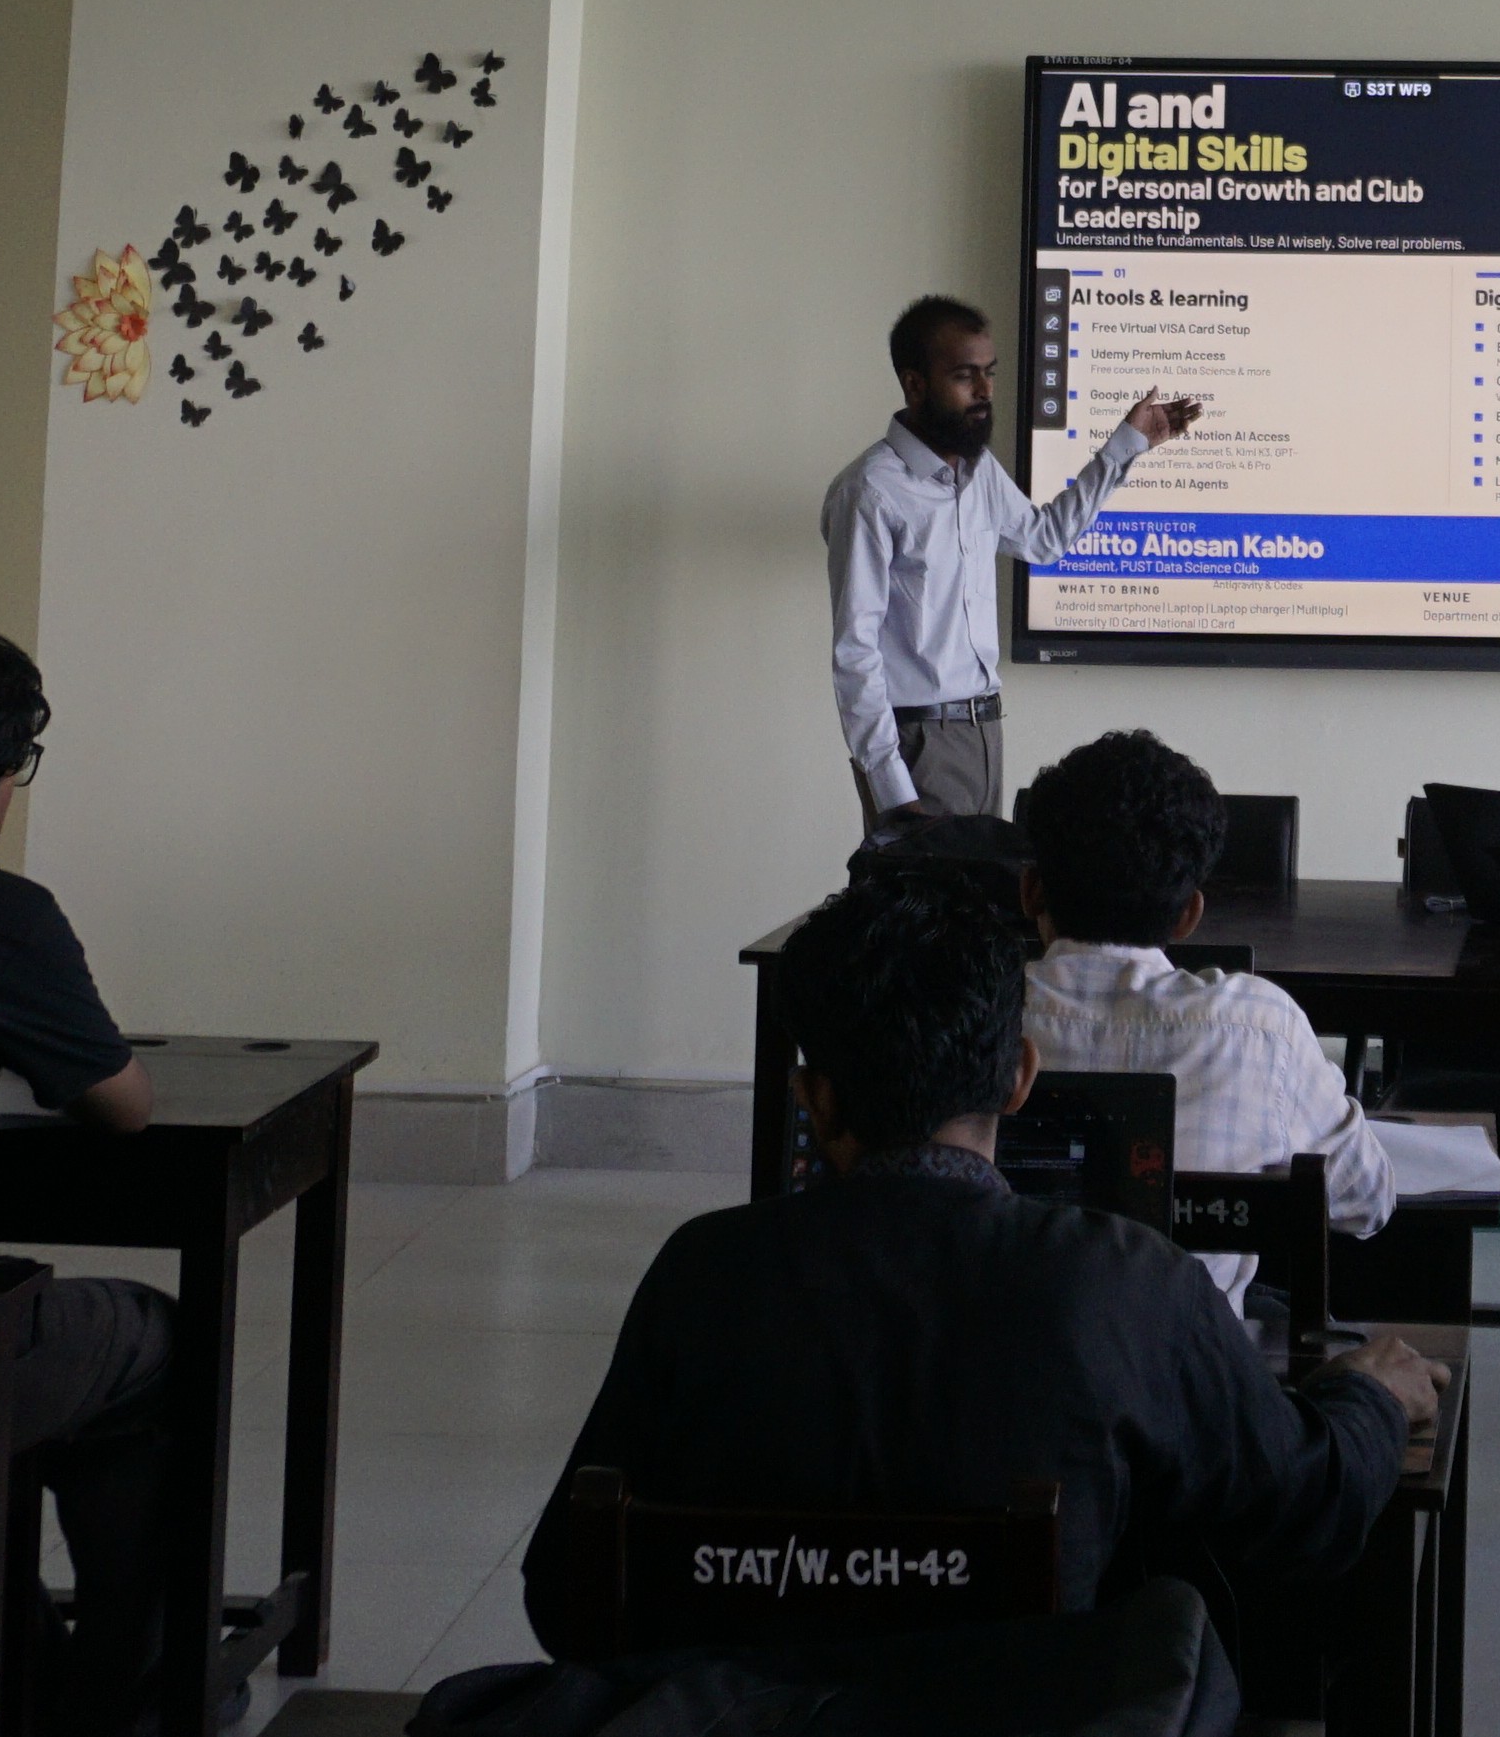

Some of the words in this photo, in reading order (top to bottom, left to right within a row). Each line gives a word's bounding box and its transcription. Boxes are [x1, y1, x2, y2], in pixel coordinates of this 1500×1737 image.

[1366, 82, 1396, 97] S3T
[1399, 83, 1432, 97] WF9
[1060, 81, 1117, 129] AI
[1127, 83, 1226, 129] and
[1058, 132, 1189, 177] Digital
[1197, 134, 1308, 173] Skills
[1058, 175, 1097, 199] for
[1101, 176, 1212, 201] Personal
[1217, 178, 1310, 203] Growth
[1314, 179, 1362, 203] and
[1367, 179, 1424, 203] Club
[1058, 204, 1200, 234] Leadership
[1056, 232, 1131, 247] Understand
[1132, 233, 1155, 247] the
[1156, 234, 1245, 249] fundamentals.
[1249, 235, 1275, 249] Use
[1276, 235, 1290, 249] AI
[1292, 235, 1335, 251] wisely.
[1338, 236, 1372, 251] Solve
[1375, 236, 1400, 251] real
[1402, 237, 1466, 254] problems.
[1114, 268, 1126, 279] 01
[1071, 288, 1091, 306] AI
[1096, 288, 1145, 306] tools
[1149, 289, 1164, 307] &
[1169, 289, 1249, 312] learning
[1091, 322, 1118, 334] Free
[1120, 322, 1157, 335] Virtual
[1159, 323, 1186, 335] VISA
[1188, 324, 1215, 335] Card
[1217, 324, 1251, 337] Setup
[1091, 348, 1130, 362] Udemy
[1132, 349, 1183, 361] Premium
[1185, 350, 1226, 362] Access
[1090, 389, 1130, 402] Google
[1132, 390, 1144, 401] AI
[1173, 390, 1215, 402] Access
[1194, 430, 1232, 442] Notion
[1234, 431, 1247, 442] AI
[1248, 431, 1291, 443] Access
[1160, 479, 1172, 489] to
[1174, 478, 1186, 489] AI
[1188, 479, 1229, 492] Agents
[1117, 521, 1197, 533] INSTRUCTOR
[1142, 533, 1239, 558] Ahosan
[1242, 534, 1325, 559] Kabbo
[1058, 559, 1118, 574] President,
[1120, 560, 1152, 573] PUST
[1155, 561, 1183, 574] Data
[1184, 561, 1231, 575] Science
[1233, 561, 1260, 575] Club
[1058, 584, 1095, 594] WHAT
[1101, 584, 1116, 595] TO
[1121, 584, 1160, 595] BRING
[1423, 591, 1471, 603] VENUE
[1054, 616, 1107, 630] University
[1109, 617, 1120, 628] ID
[1121, 617, 1146, 628] Card
[1152, 617, 1196, 629] National
[1198, 617, 1209, 629] ID
[1210, 618, 1235, 630] Card
[1423, 610, 1489, 624] Department
